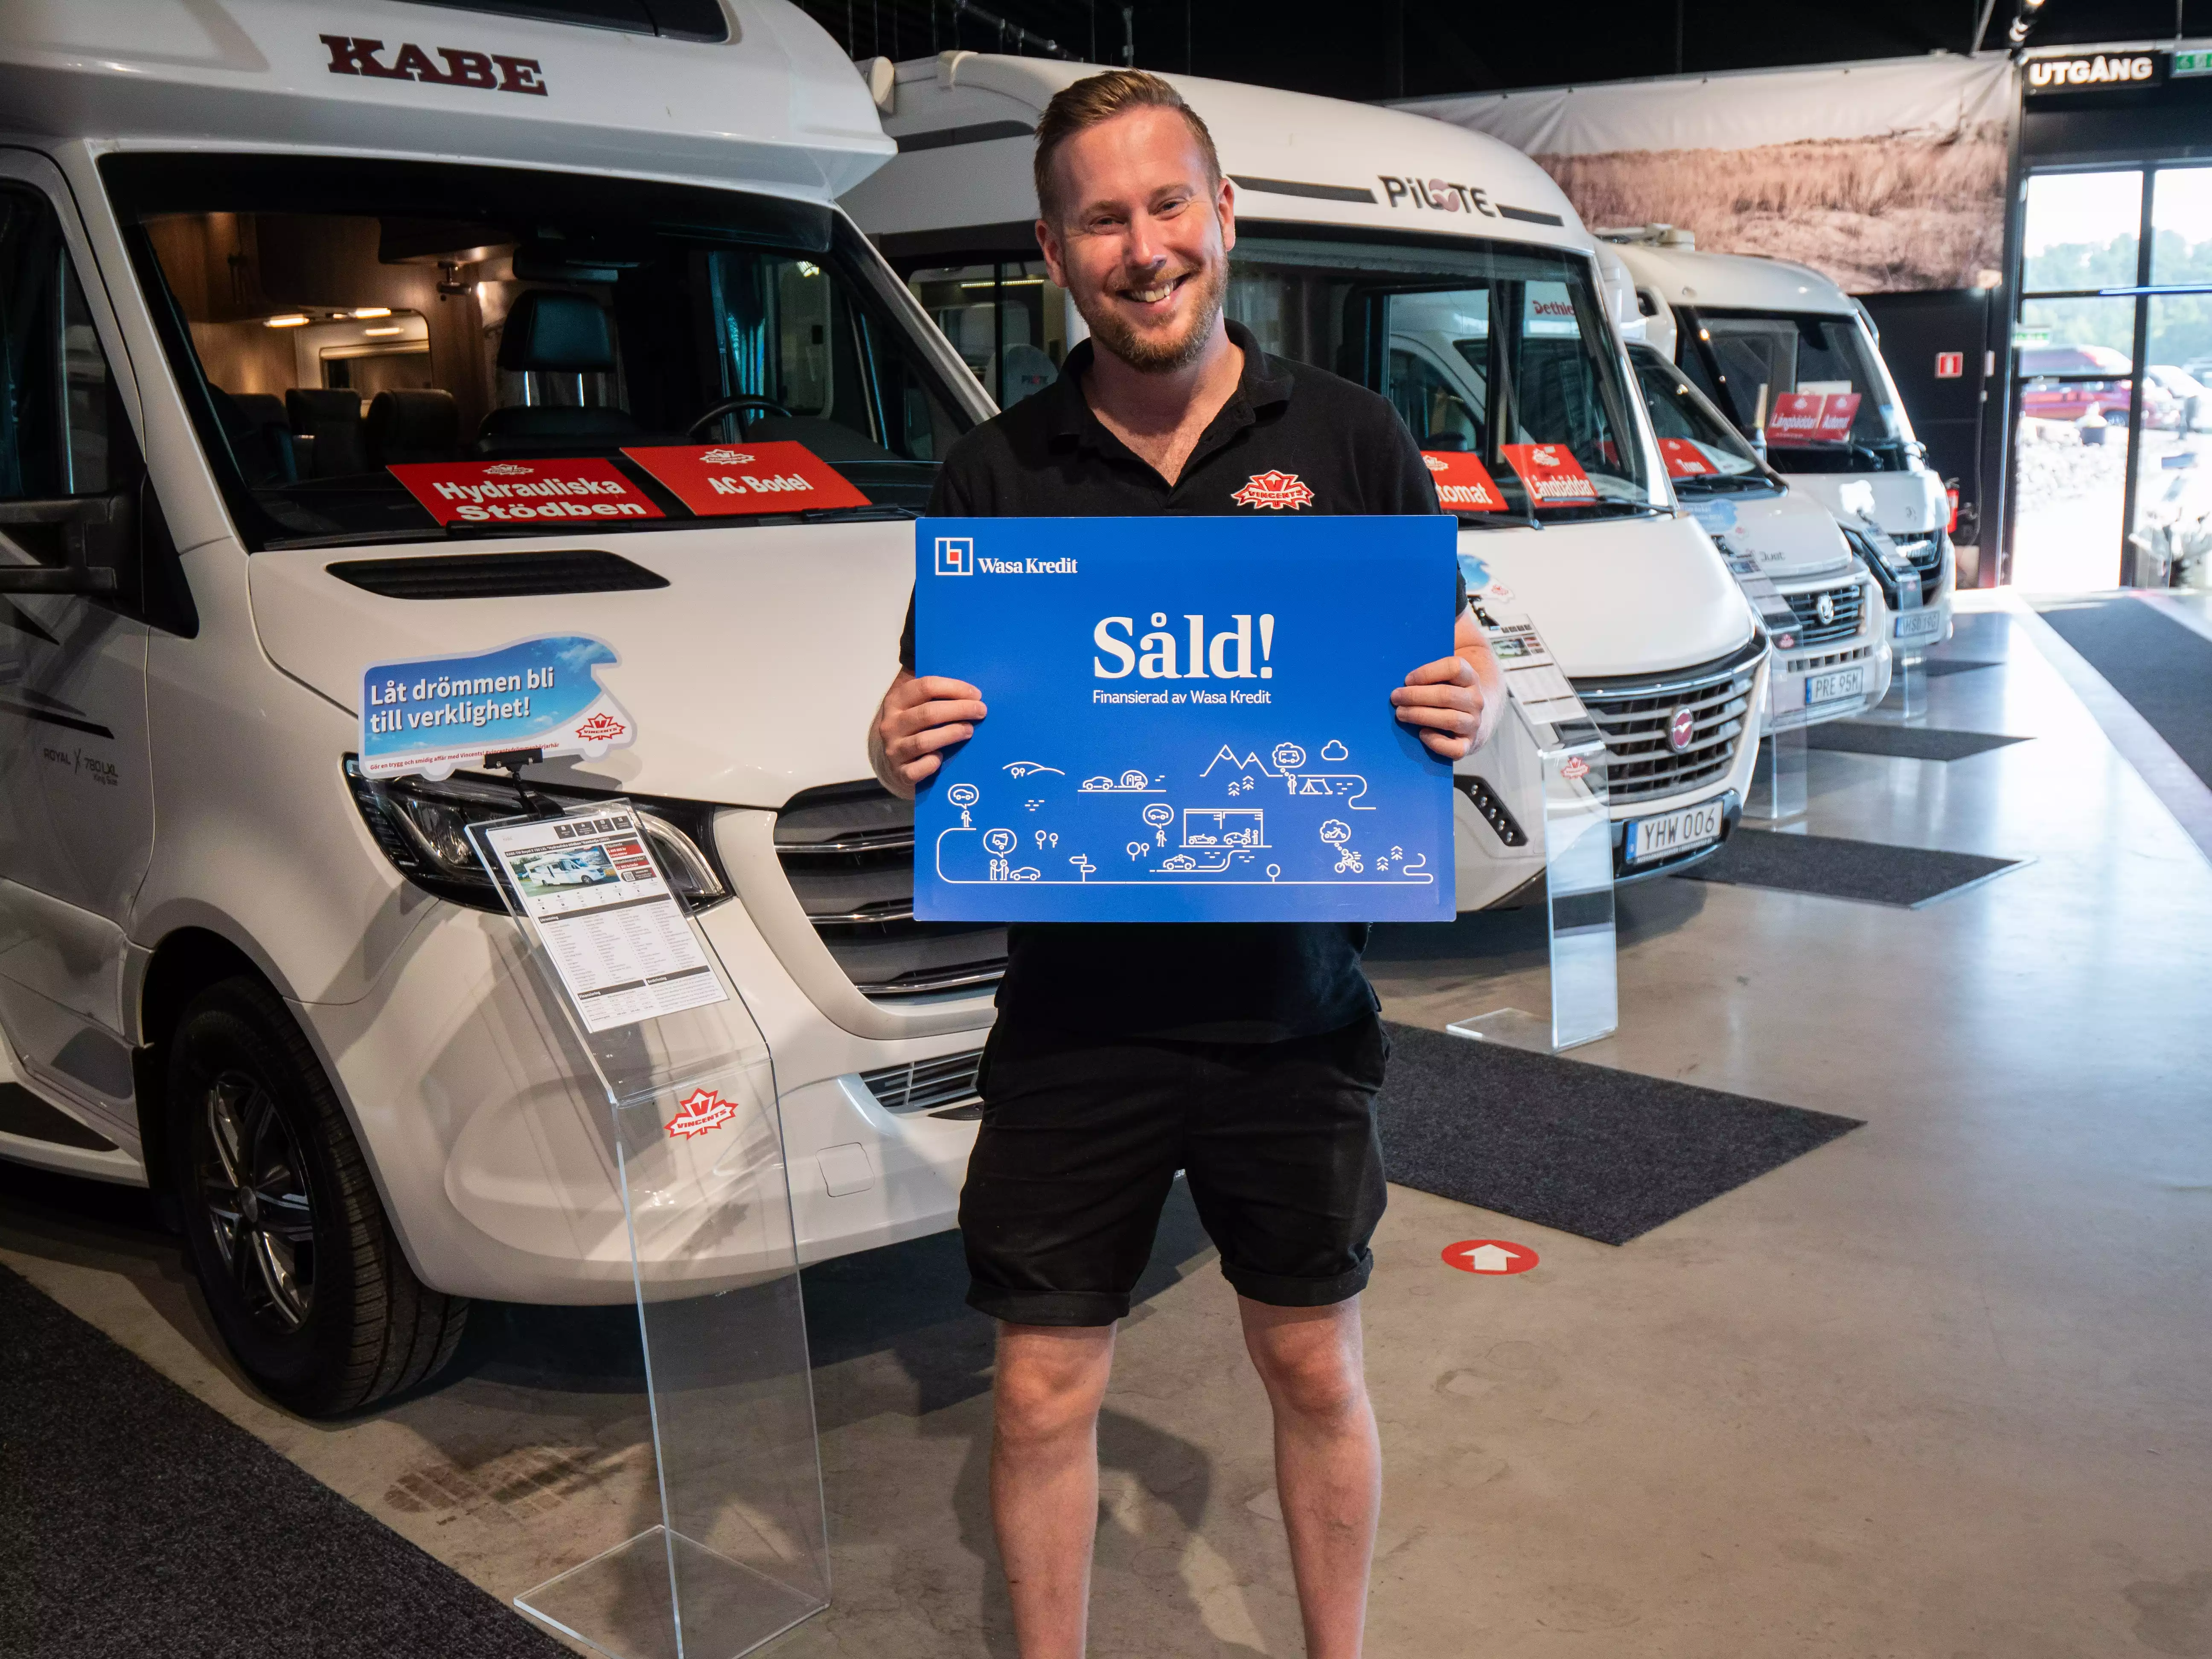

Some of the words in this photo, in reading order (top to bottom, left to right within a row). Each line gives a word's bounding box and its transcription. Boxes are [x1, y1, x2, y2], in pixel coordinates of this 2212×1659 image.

[319, 34, 548, 96] KABE
[2029, 55, 2152, 85] UTGÅNG
[432, 477, 626, 503] Hydrauliska
[707, 477, 747, 495] AC
[740, 473, 814, 493] Bodel
[1248, 489, 1303, 499] VINCENTS
[1435, 482, 1493, 504] tomat
[455, 502, 646, 521] Stödben
[978, 558, 1024, 573] Wasa
[1025, 557, 1078, 573] Kredit
[1094, 612, 1275, 678] Såld!
[371, 680, 407, 705] Låt
[412, 672, 521, 700] drömmen
[527, 667, 555, 689] bli
[1093, 690, 1168, 704] Finansierad
[1172, 693, 1187, 704] av
[1190, 690, 1227, 704] Wasa
[1230, 690, 1272, 704] Kredit
[1816, 677, 1836, 698] PRE
[370, 708, 402, 733] till
[407, 697, 530, 728] verklighet!
[44, 748, 71, 765] ROYAL
[1645, 817, 1679, 851] YHW
[1682, 808, 1715, 840] 006
[579, 990, 601, 999] Finansiering
[677, 1109, 727, 1129] VINCENTS
